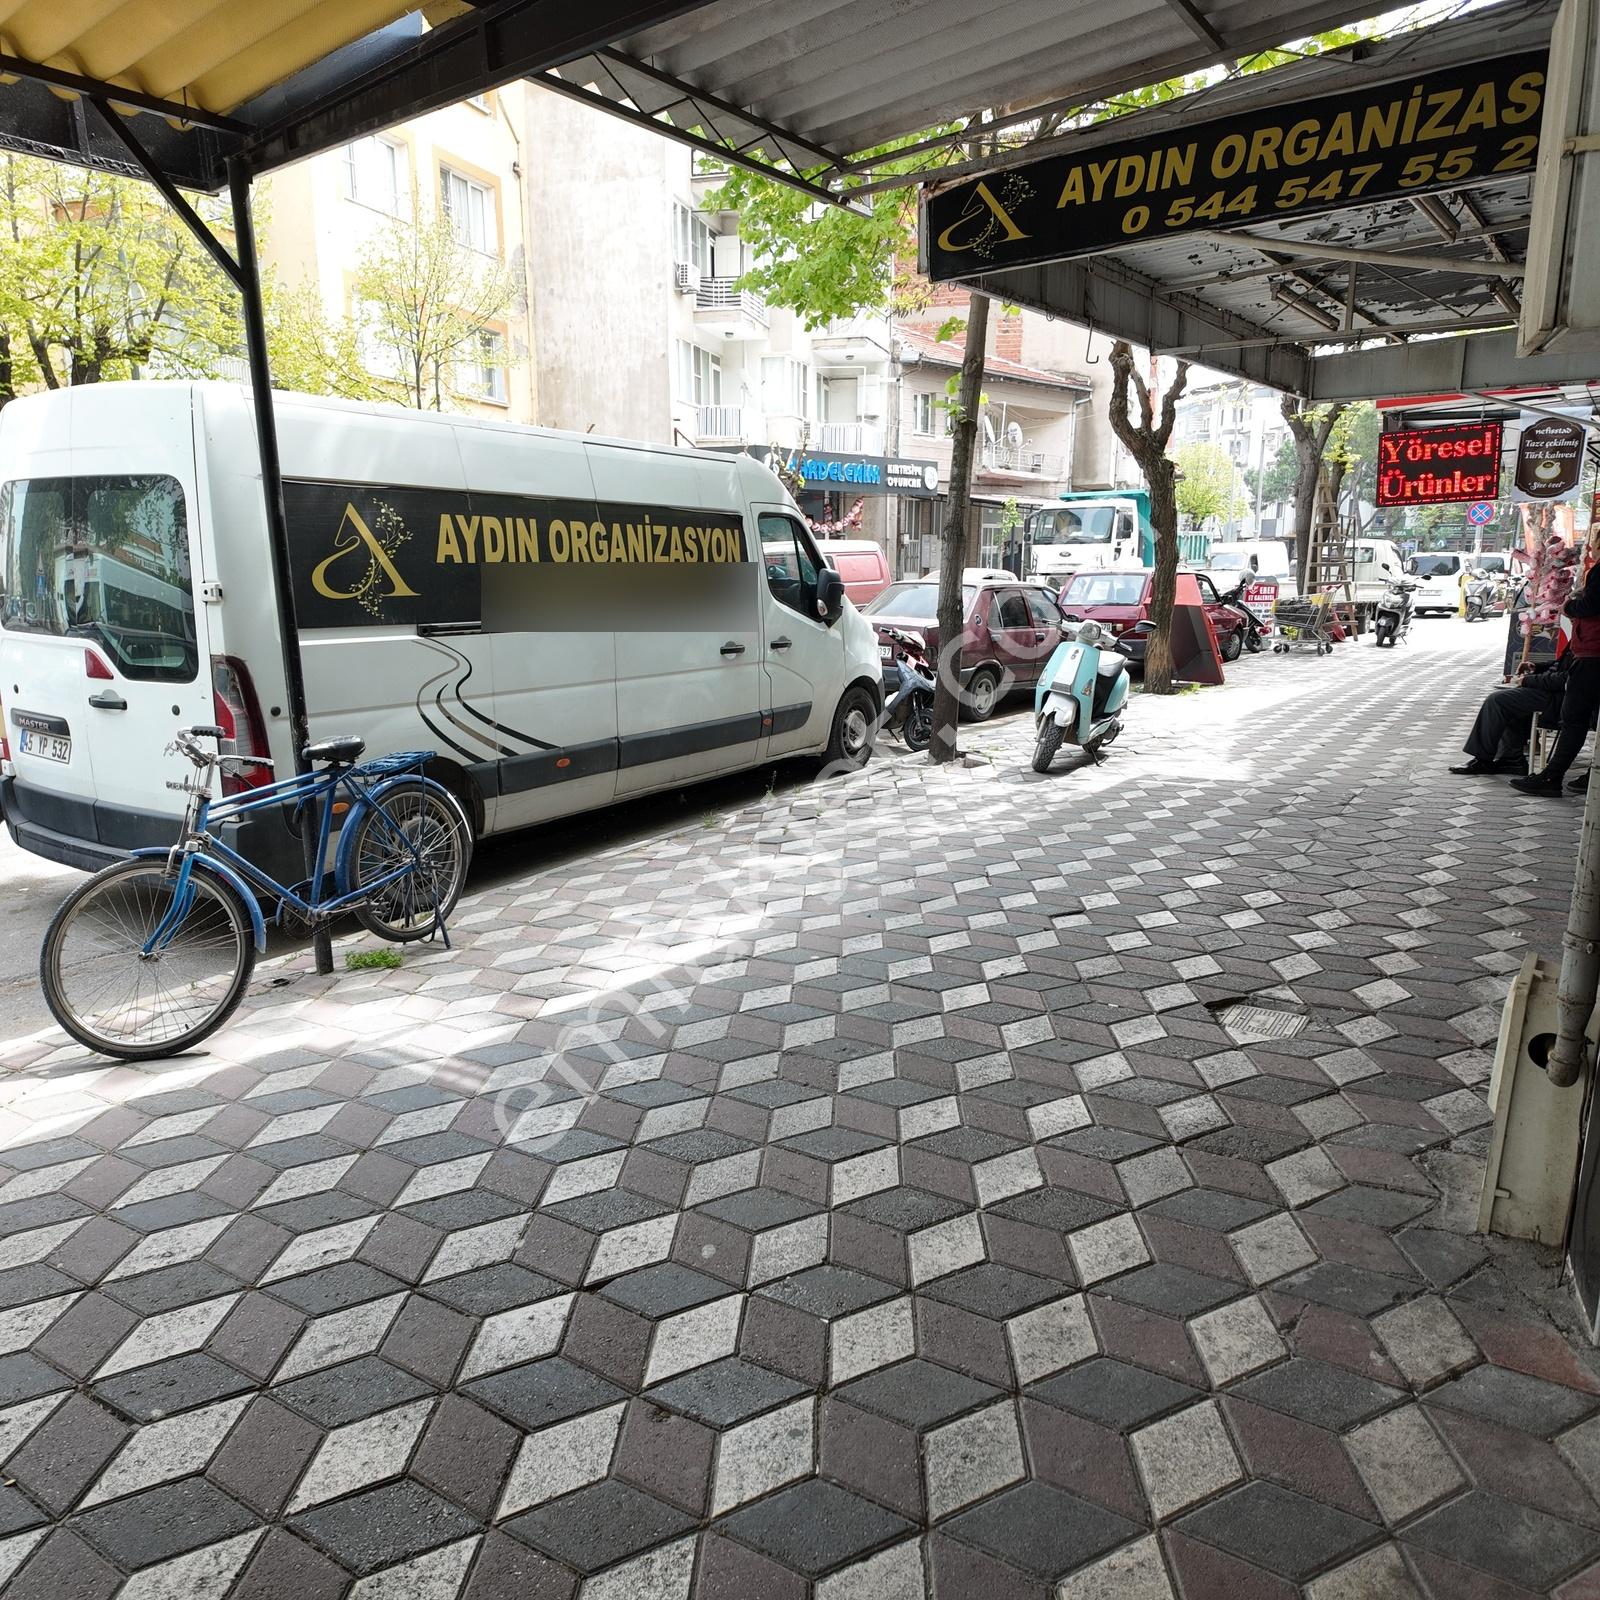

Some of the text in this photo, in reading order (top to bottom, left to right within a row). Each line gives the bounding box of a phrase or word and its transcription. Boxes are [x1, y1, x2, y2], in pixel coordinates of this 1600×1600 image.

[1056, 71, 1545, 210] AYDIN ORGANİZAS
[1121, 135, 1539, 235] 0 544 547 55 2
[1383, 431, 1493, 464] Yöresel
[1524, 451, 1577, 459] Türk kahvesi
[1525, 438, 1580, 448] Taze çekilmiş
[1380, 469, 1492, 498] Ürünler
[436, 513, 741, 564] AYDIN ORGANİZASYON
[19, 718, 49, 730] MASTER
[38, 735, 48, 755] YP
[52, 739, 69, 760] 532
